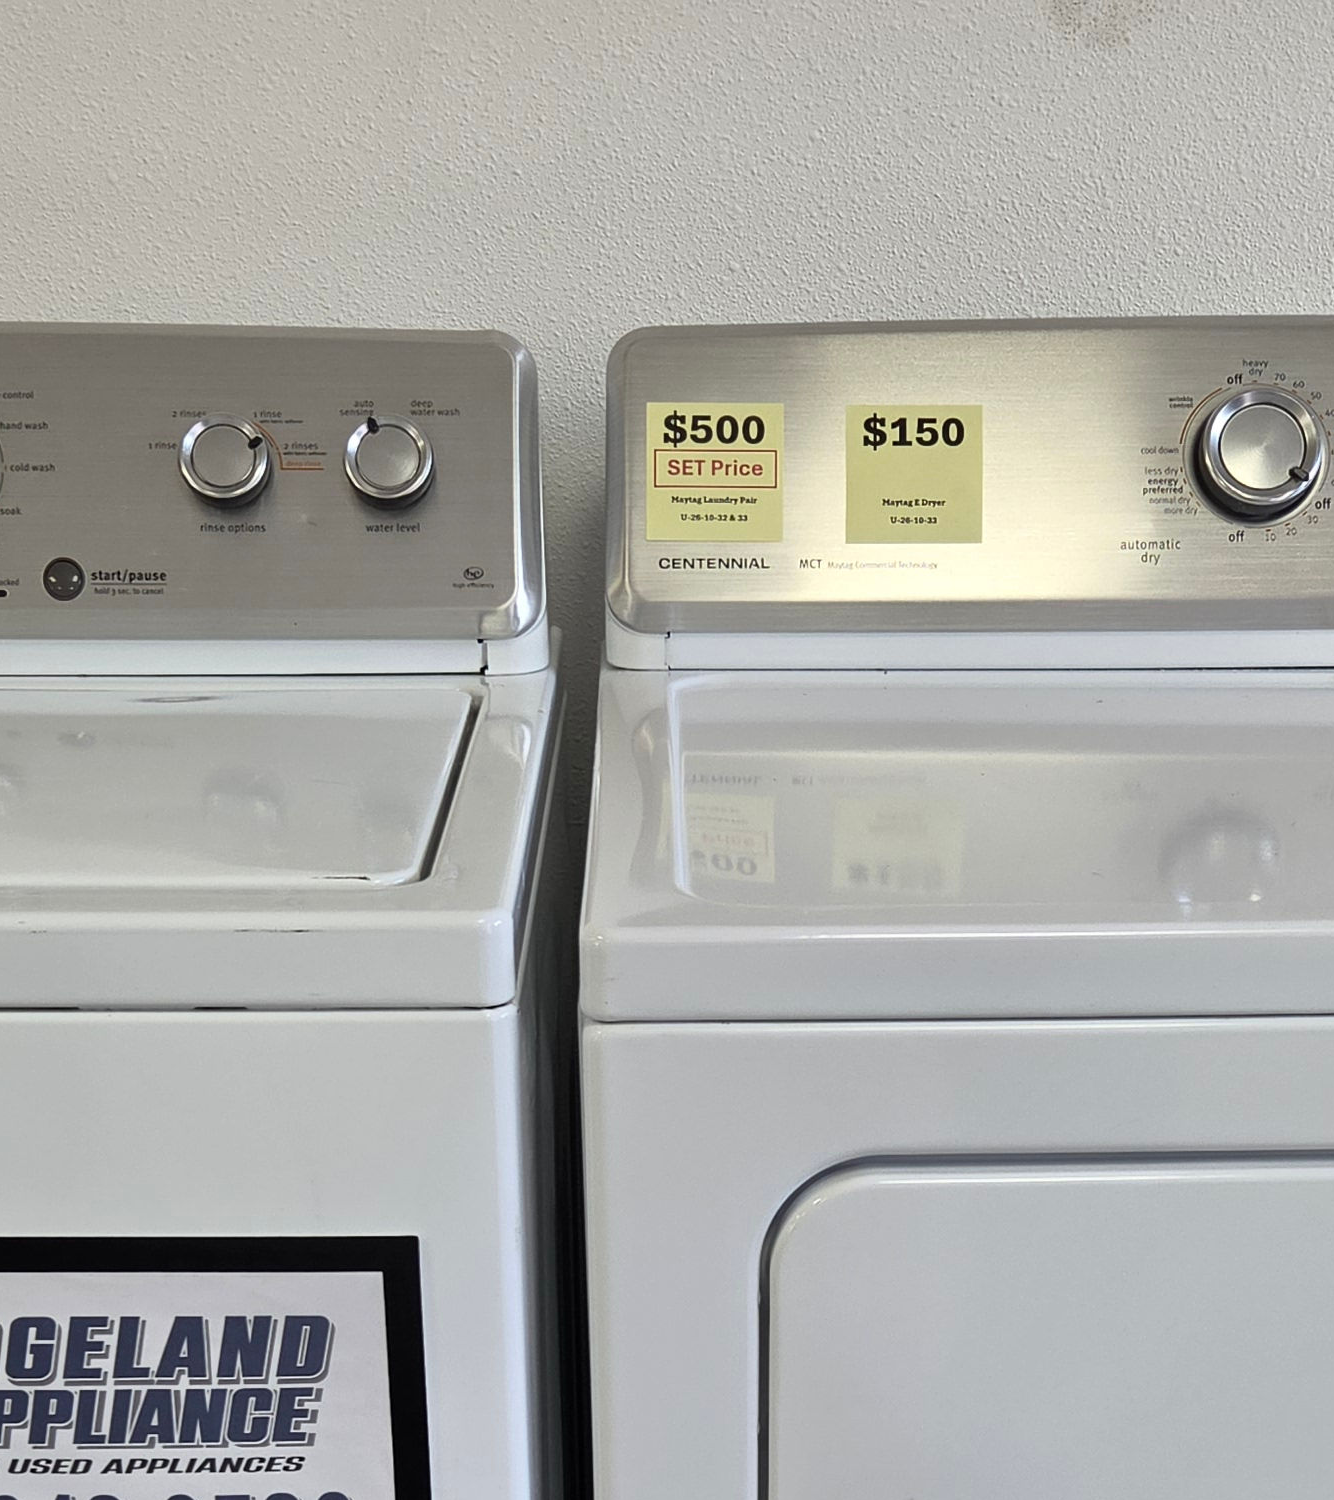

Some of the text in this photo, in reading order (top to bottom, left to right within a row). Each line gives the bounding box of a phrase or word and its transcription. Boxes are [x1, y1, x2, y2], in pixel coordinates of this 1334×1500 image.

[1242, 358, 1269, 368] heavy
[1249, 367, 1263, 377] dry
[1274, 372, 1286, 381] 70
[1227, 373, 1243, 384] off
[1293, 380, 1305, 389] 60
[2, 391, 34, 399] control
[1310, 392, 1322, 400] 50
[353, 400, 374, 408] auto
[410, 400, 433, 409] deep
[172, 410, 178, 418] 2
[260, 410, 282, 418] rinse
[410, 408, 460, 416] water wash
[0, 421, 49, 430] hand wash
[663, 410, 765, 448] $500
[863, 413, 965, 451] $150
[155, 442, 178, 450] rinse
[291, 441, 319, 450] rinses
[1141, 446, 1179, 455] cool down
[10, 463, 55, 472] cold wash
[667, 459, 763, 476] SET Price
[1145, 467, 1179, 476] less dry
[1148, 478, 1179, 487] energy
[1142, 486, 1183, 496] preferred
[671, 496, 757, 505] Maytag Laundry Pair
[882, 499, 946, 508] Maytag E Dryer
[1178, 497, 1191, 505] dry
[1315, 497, 1331, 510] off
[0, 506, 21, 515] soak
[1185, 507, 1198, 516] dry
[681, 514, 728, 522] U-26-10-32
[890, 516, 938, 524] U-26-10-33
[1307, 515, 1319, 524] 30
[200, 522, 266, 534] rinse options
[365, 523, 421, 533] water level
[1285, 527, 1297, 536] 20
[1228, 530, 1245, 542] off
[1265, 533, 1276, 542] 10
[1120, 539, 1181, 550] automatic
[658, 557, 770, 569] CENTENNIAL
[1141, 552, 1160, 565] dry
[799, 558, 822, 569] MCT
[91, 568, 167, 583] start/pause
[8, 1457, 93, 1475] USED
[100, 1456, 306, 1475] APPLIANCES
